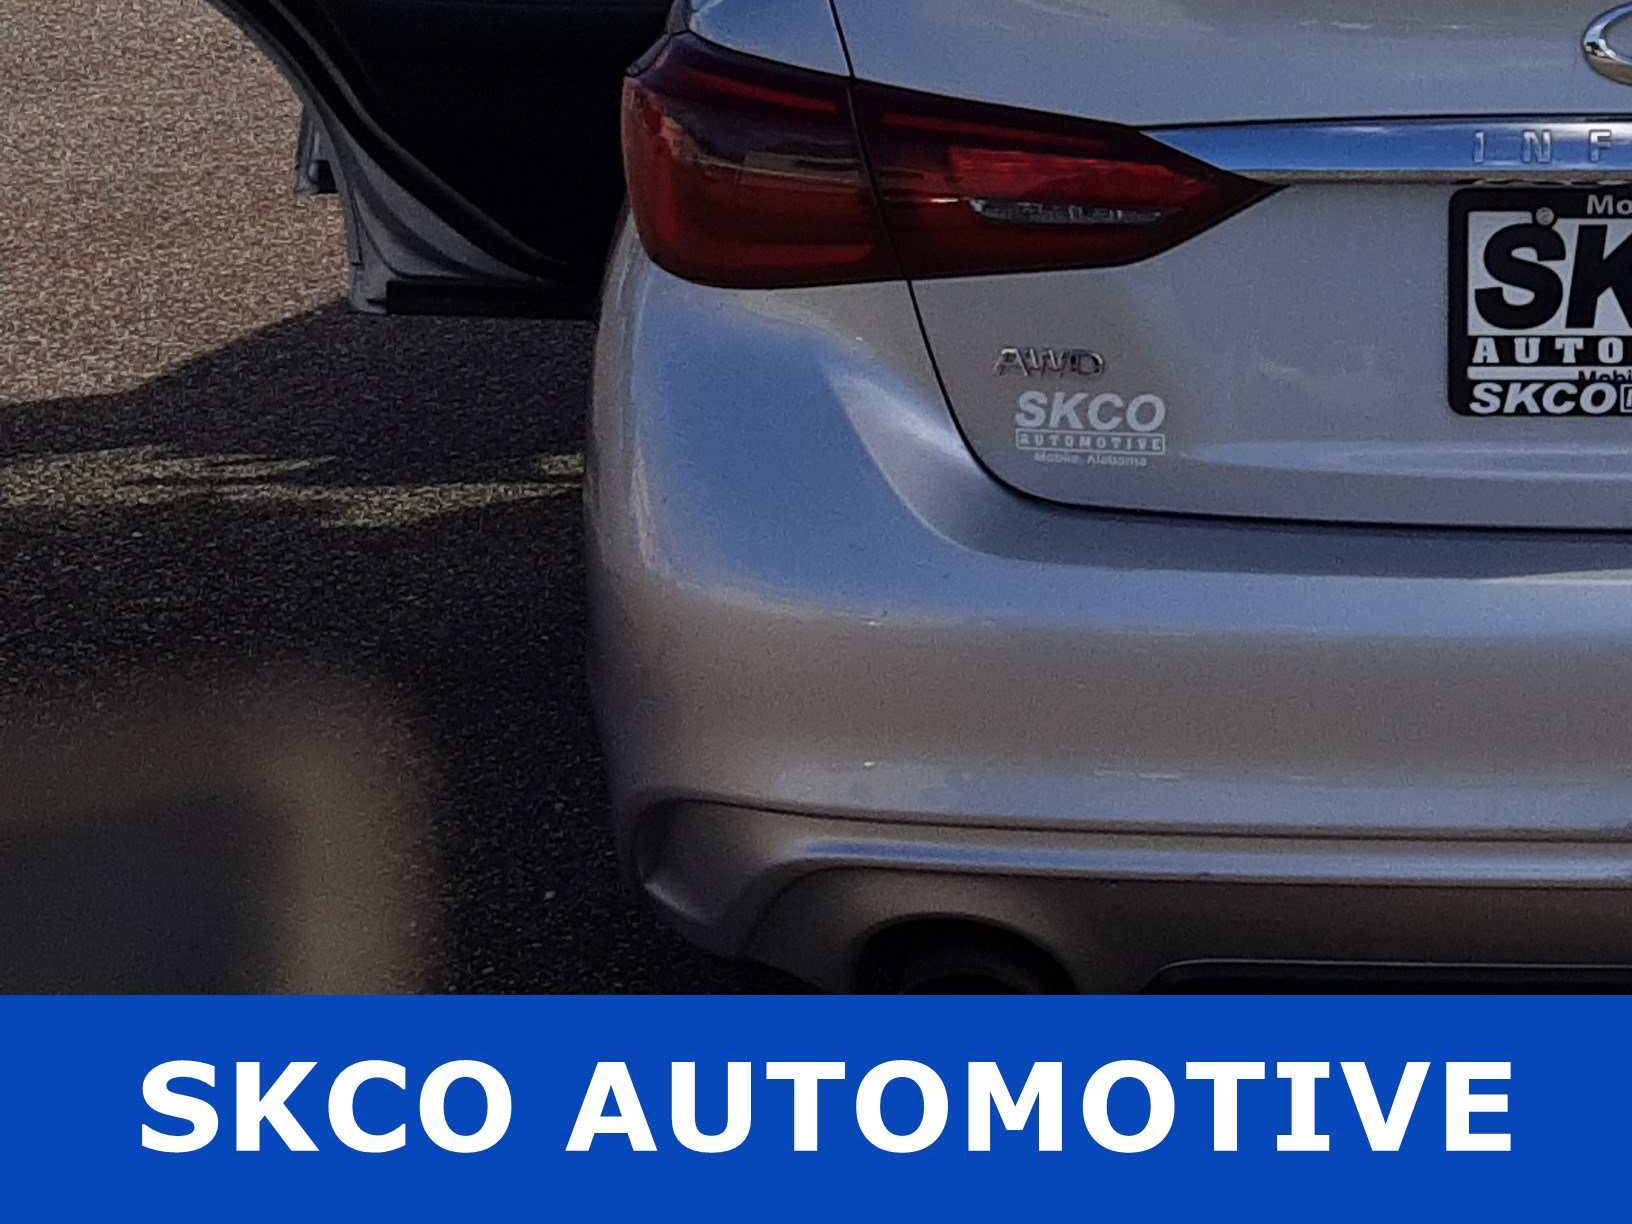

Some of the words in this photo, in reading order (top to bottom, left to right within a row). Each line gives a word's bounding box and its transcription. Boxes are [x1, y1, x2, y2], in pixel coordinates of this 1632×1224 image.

[993, 347, 1105, 377] AWD
[1015, 390, 1166, 432] SKCO
[1469, 382, 1617, 414] SKCO
[1019, 433, 1163, 451] AUTOMOTIVE
